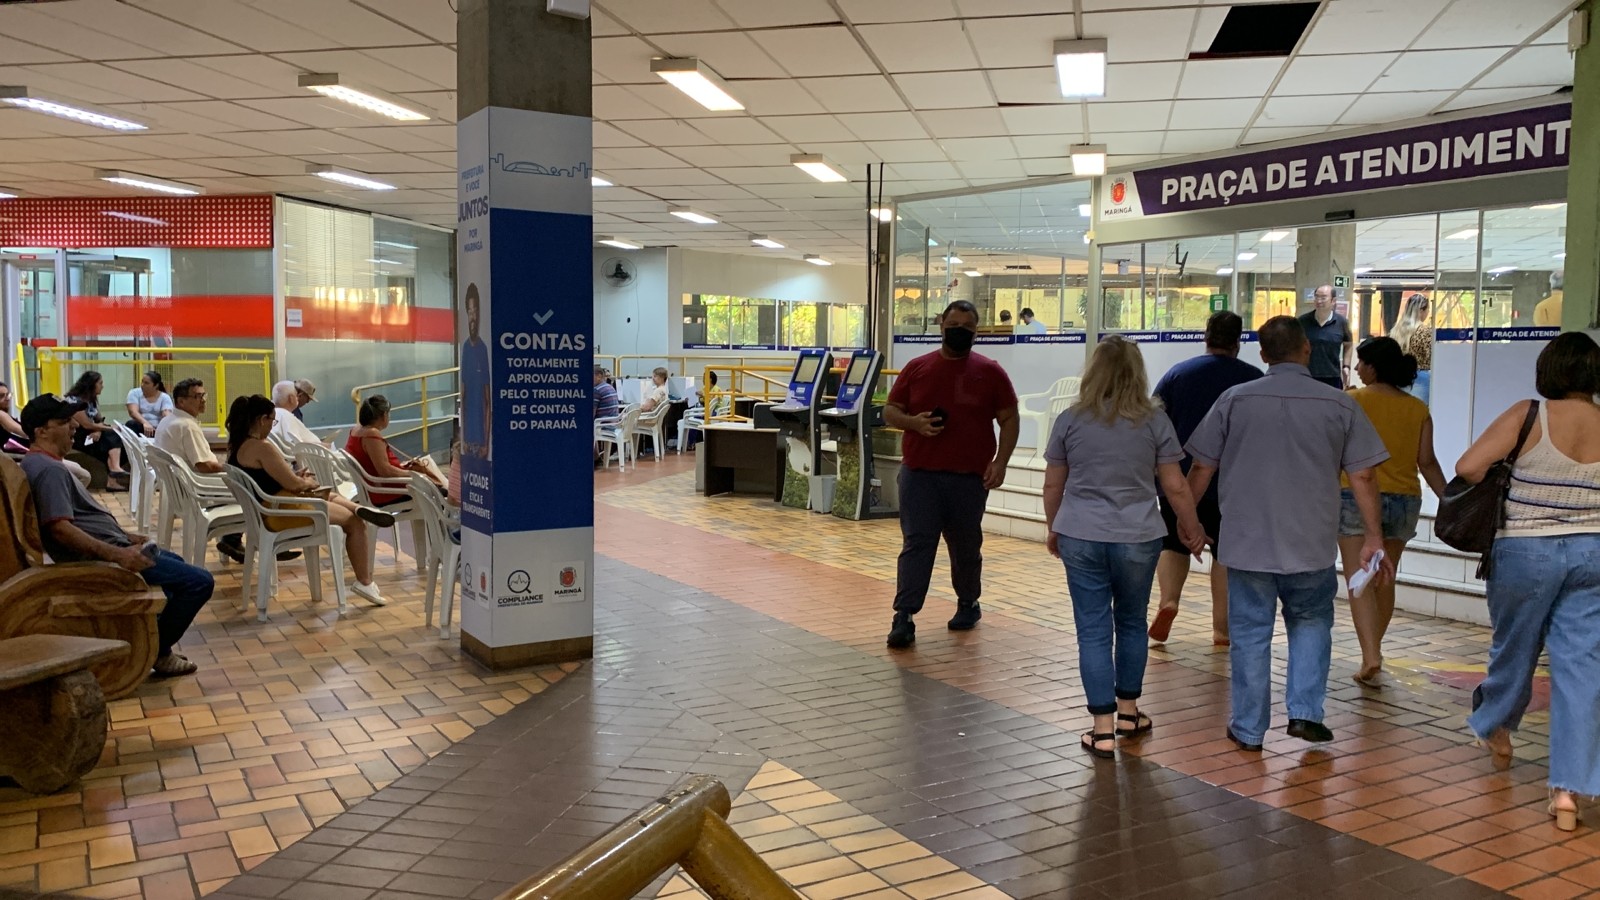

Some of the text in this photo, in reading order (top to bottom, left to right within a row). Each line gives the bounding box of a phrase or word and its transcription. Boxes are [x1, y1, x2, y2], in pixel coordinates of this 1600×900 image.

[1161, 120, 1571, 205] PRAÇA DE ATENDIMENT
[458, 195, 489, 223] JUNTOS
[469, 228, 478, 238] POR
[500, 332, 586, 351] CONTAS
[507, 357, 580, 368] TOTALMENTE
[507, 373, 579, 383] APROVADAS
[500, 389, 587, 399] PELO TRIBUNAL
[512, 404, 576, 414] DE CONTAS
[510, 417, 577, 430] DO PARANÁ
[469, 472, 489, 490] CIDADE
[480, 494, 484, 505] E
[554, 587, 582, 595] MARINGÁ
[497, 594, 544, 604] COMPLIANCE
